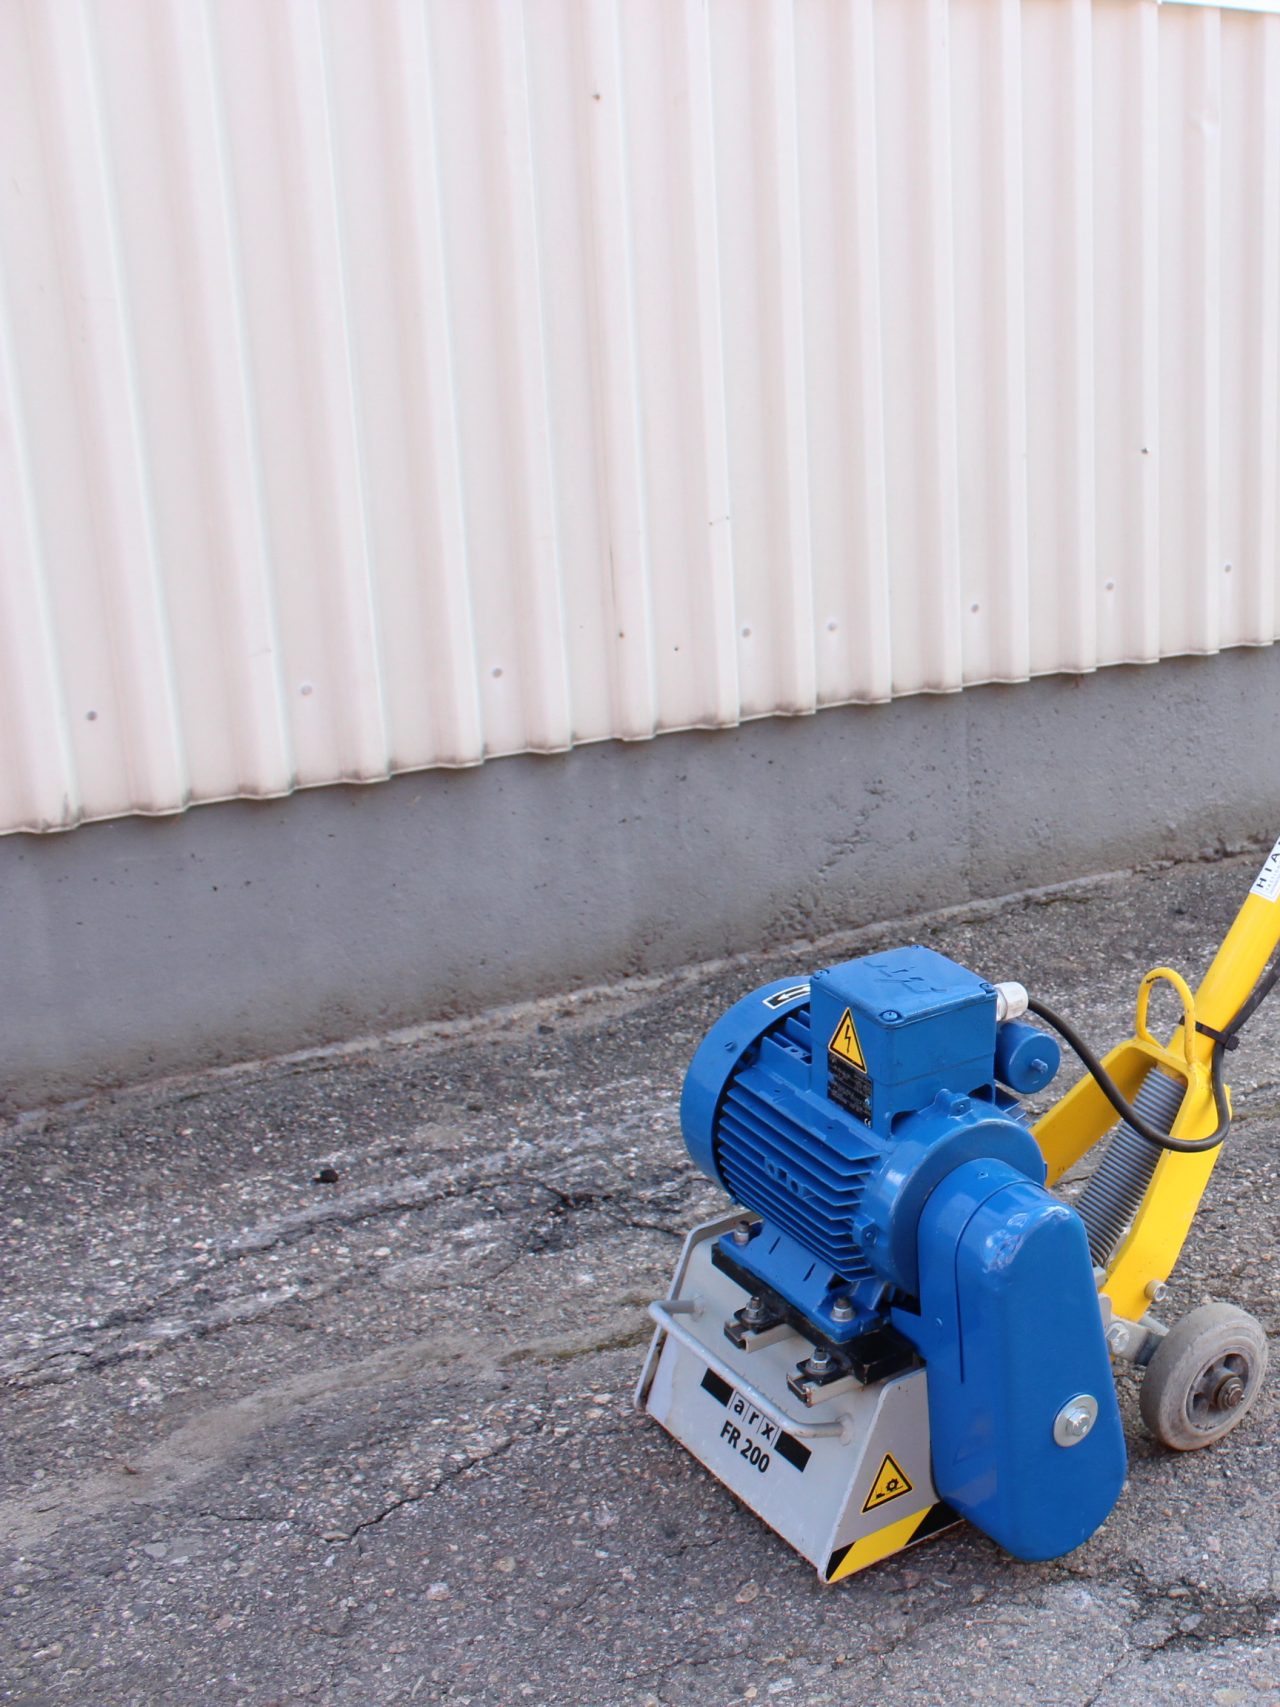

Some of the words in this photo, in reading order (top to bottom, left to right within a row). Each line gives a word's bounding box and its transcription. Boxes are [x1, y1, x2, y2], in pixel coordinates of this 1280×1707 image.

[733, 1399, 775, 1441] arx
[720, 1419, 742, 1450] FR
[740, 1438, 770, 1474] 200
